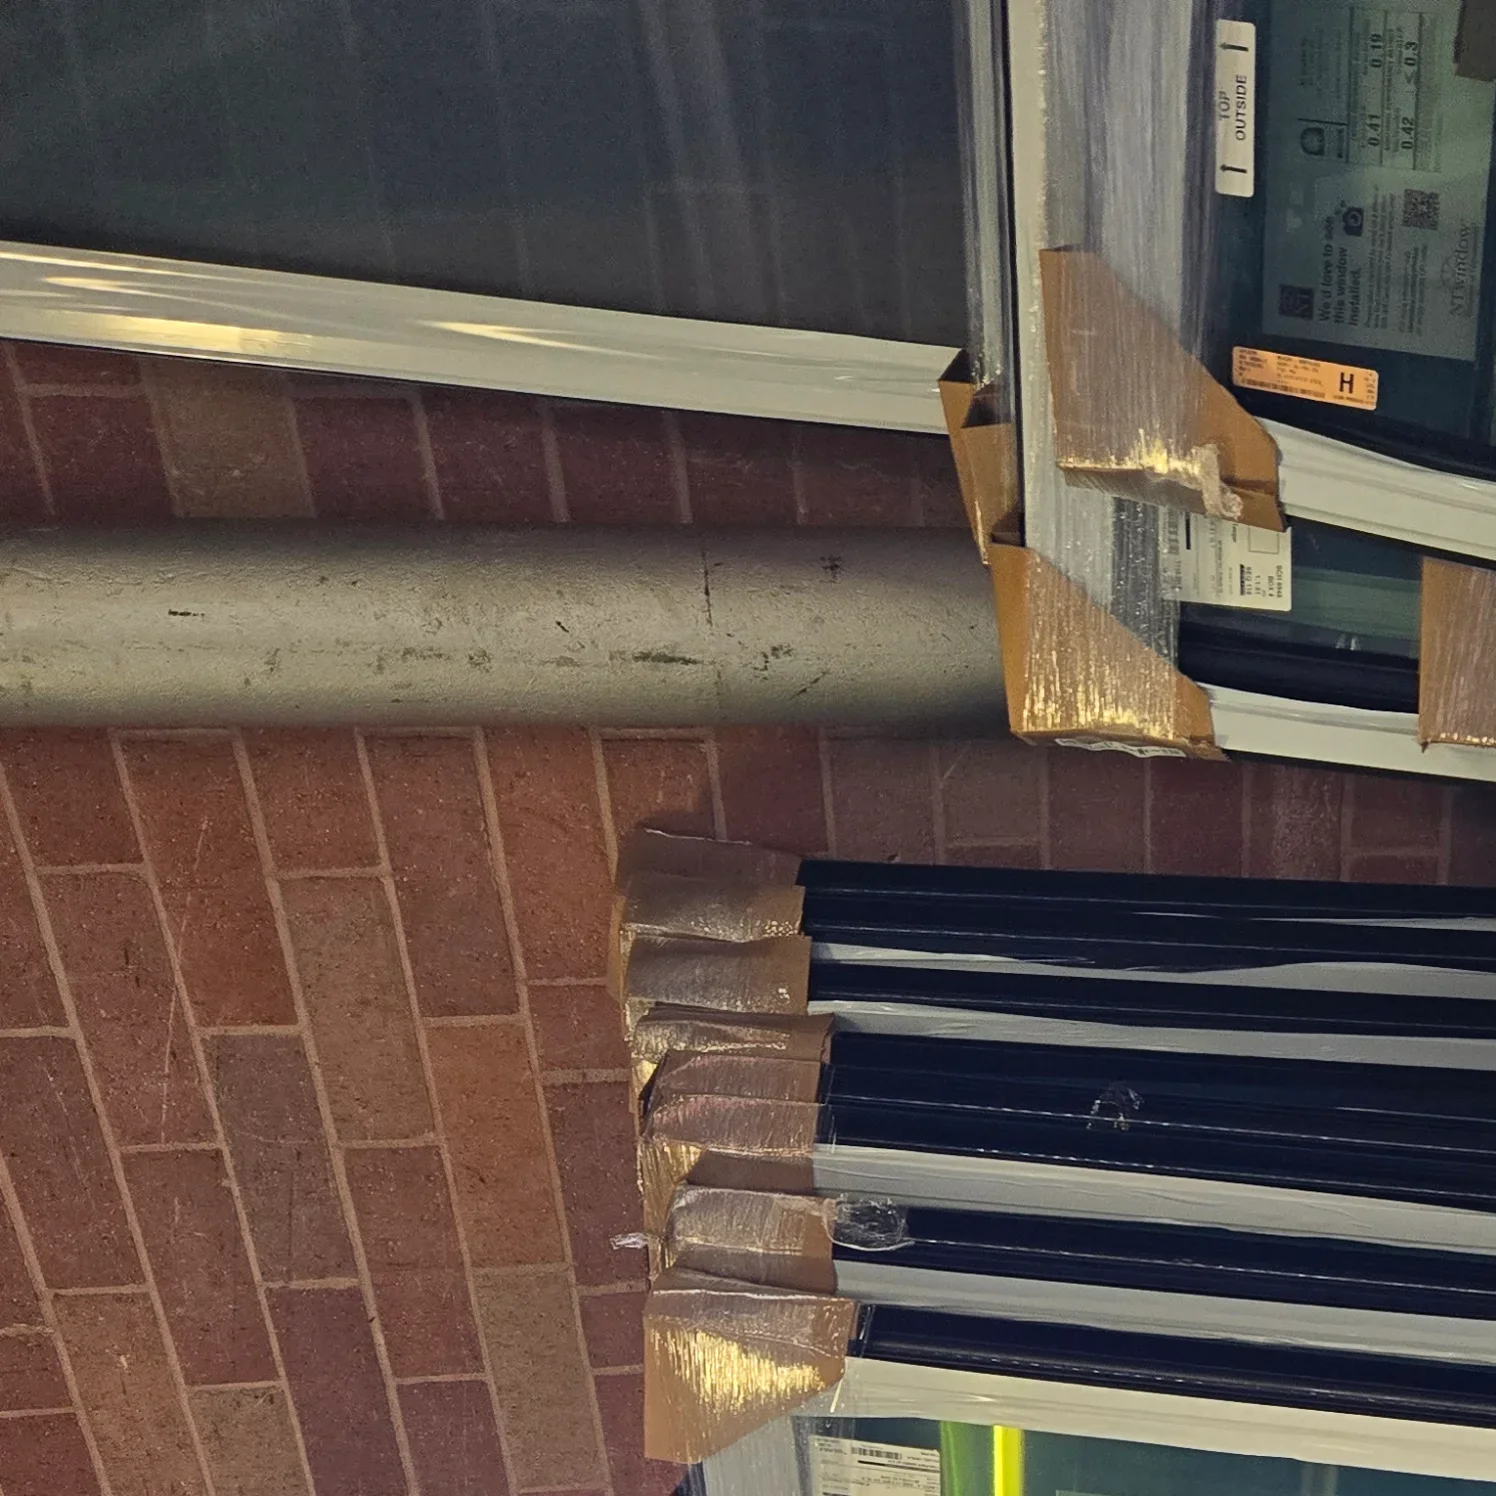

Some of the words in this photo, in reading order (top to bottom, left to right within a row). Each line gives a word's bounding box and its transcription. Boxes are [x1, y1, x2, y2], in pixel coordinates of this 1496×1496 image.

[1367, 33, 1383, 67] 0.19
[1404, 41, 1417, 66] 0.3
[1218, 90, 1229, 120] TOP
[1235, 74, 1246, 140] OUTSIDE
[1365, 114, 1381, 146] 0.41
[1400, 116, 1414, 149] 0.42
[1334, 247, 1347, 296] window
[1332, 299, 1345, 324] this
[1338, 371, 1356, 394] H
